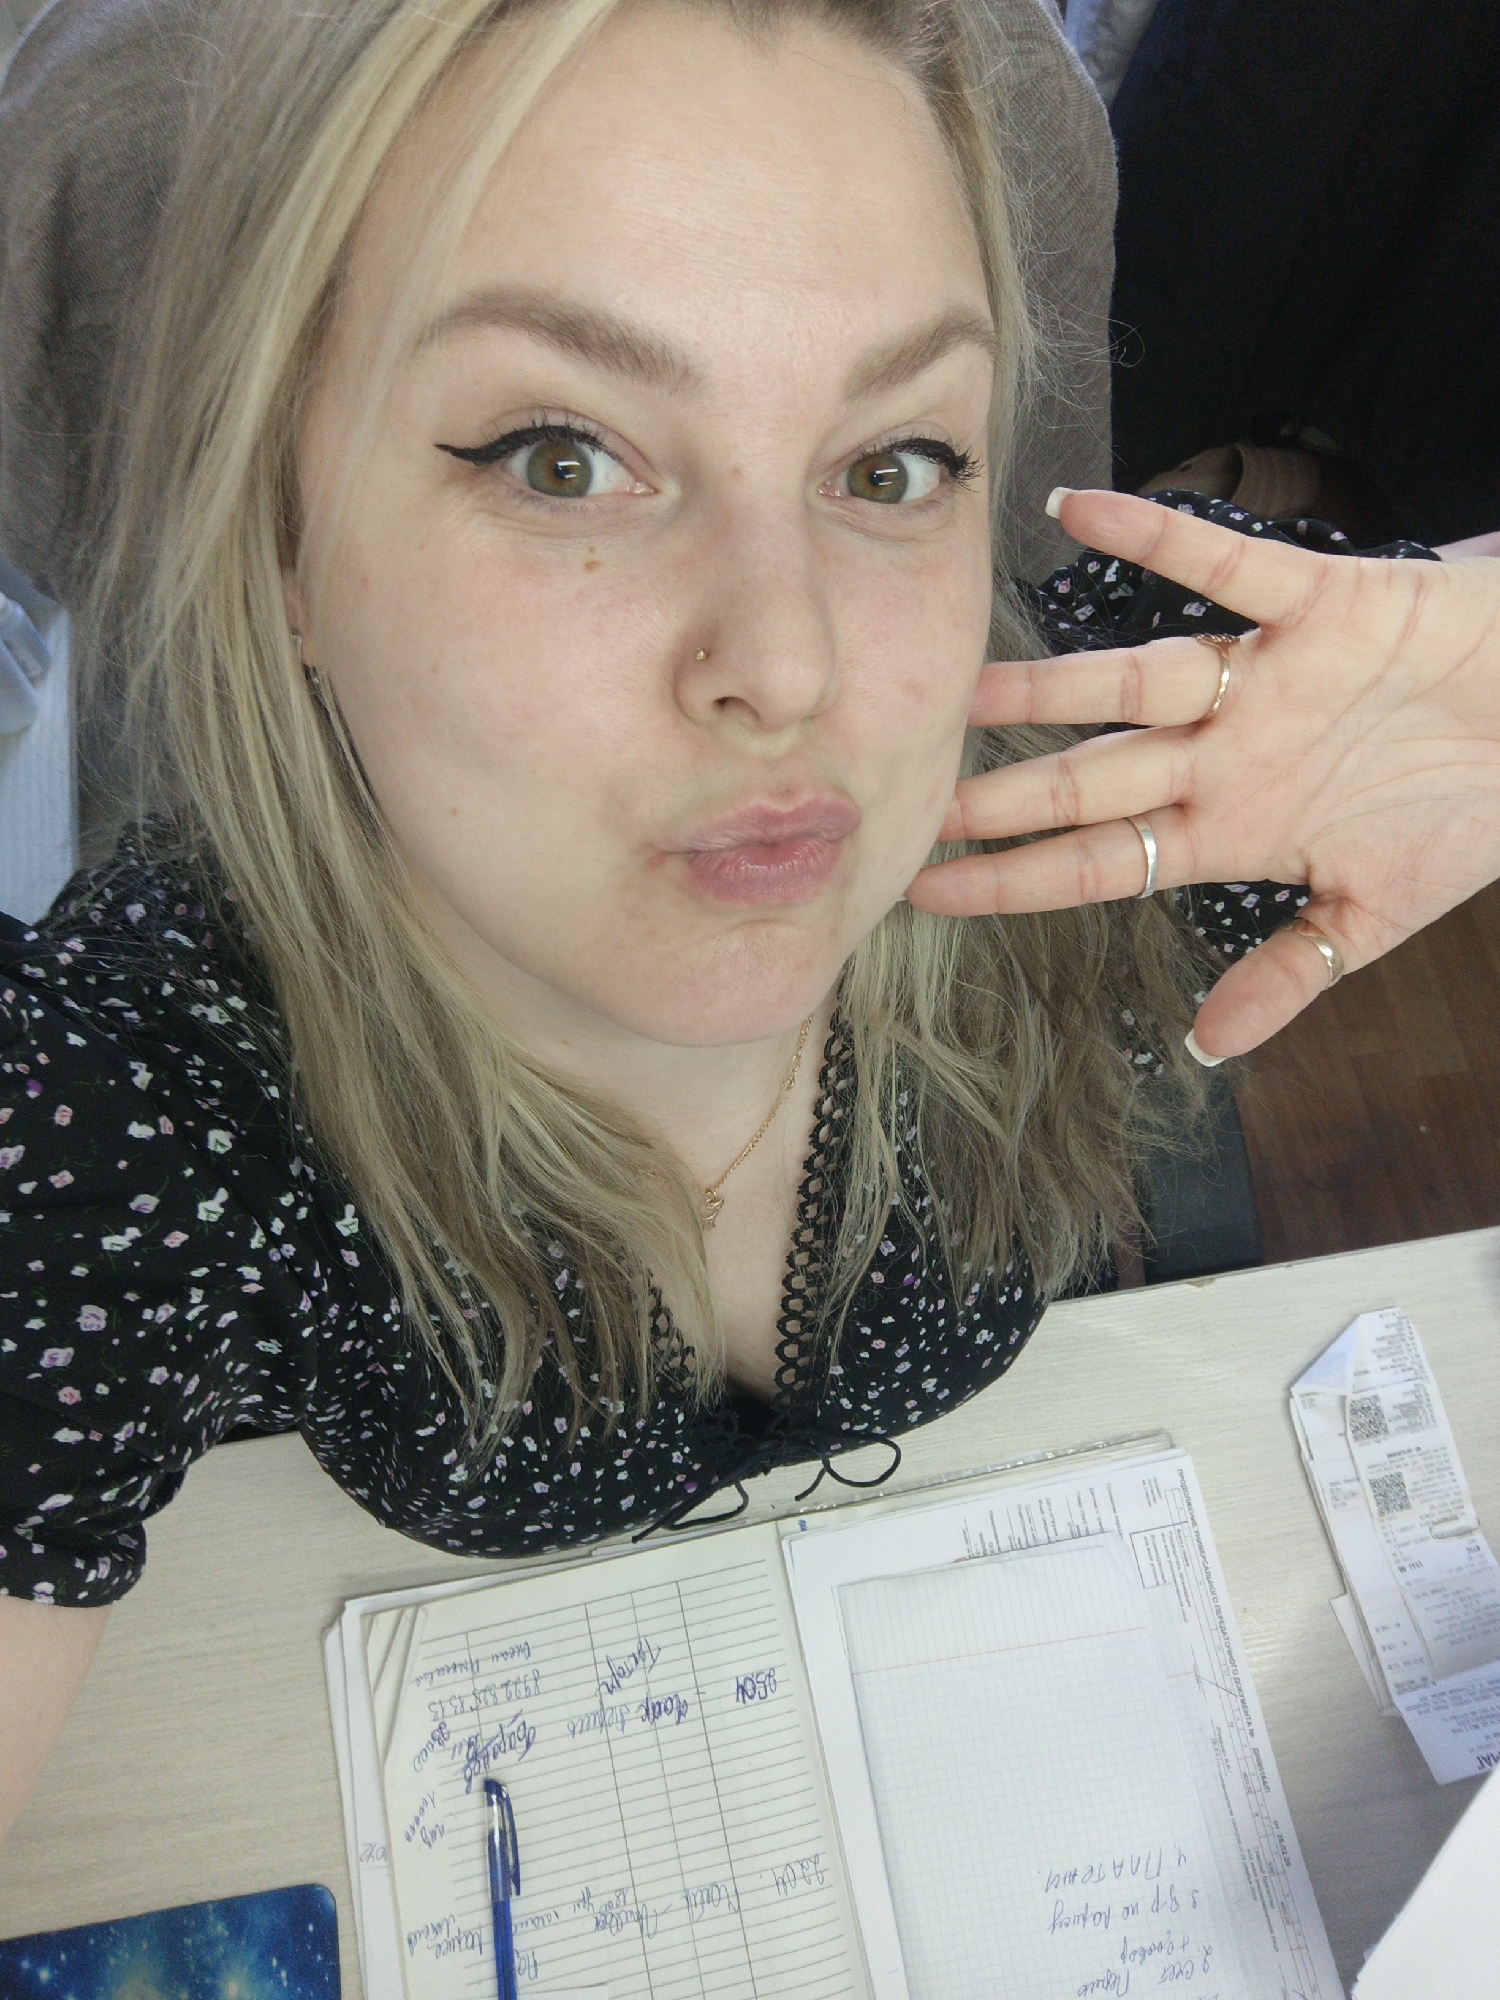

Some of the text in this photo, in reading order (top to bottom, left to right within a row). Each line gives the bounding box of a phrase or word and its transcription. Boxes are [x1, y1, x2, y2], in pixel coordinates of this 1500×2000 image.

[1176, 1468, 1198, 1528] ПРОДОЛЖЕНИЕ
[1192, 1529, 1219, 1604] УНИВЕРСАЛЬНОГО
[1213, 1604, 1238, 1675] ПЕРЕДАТОЧНОГО
[1232, 1676, 1253, 1727] ДОКУМЕНТА
